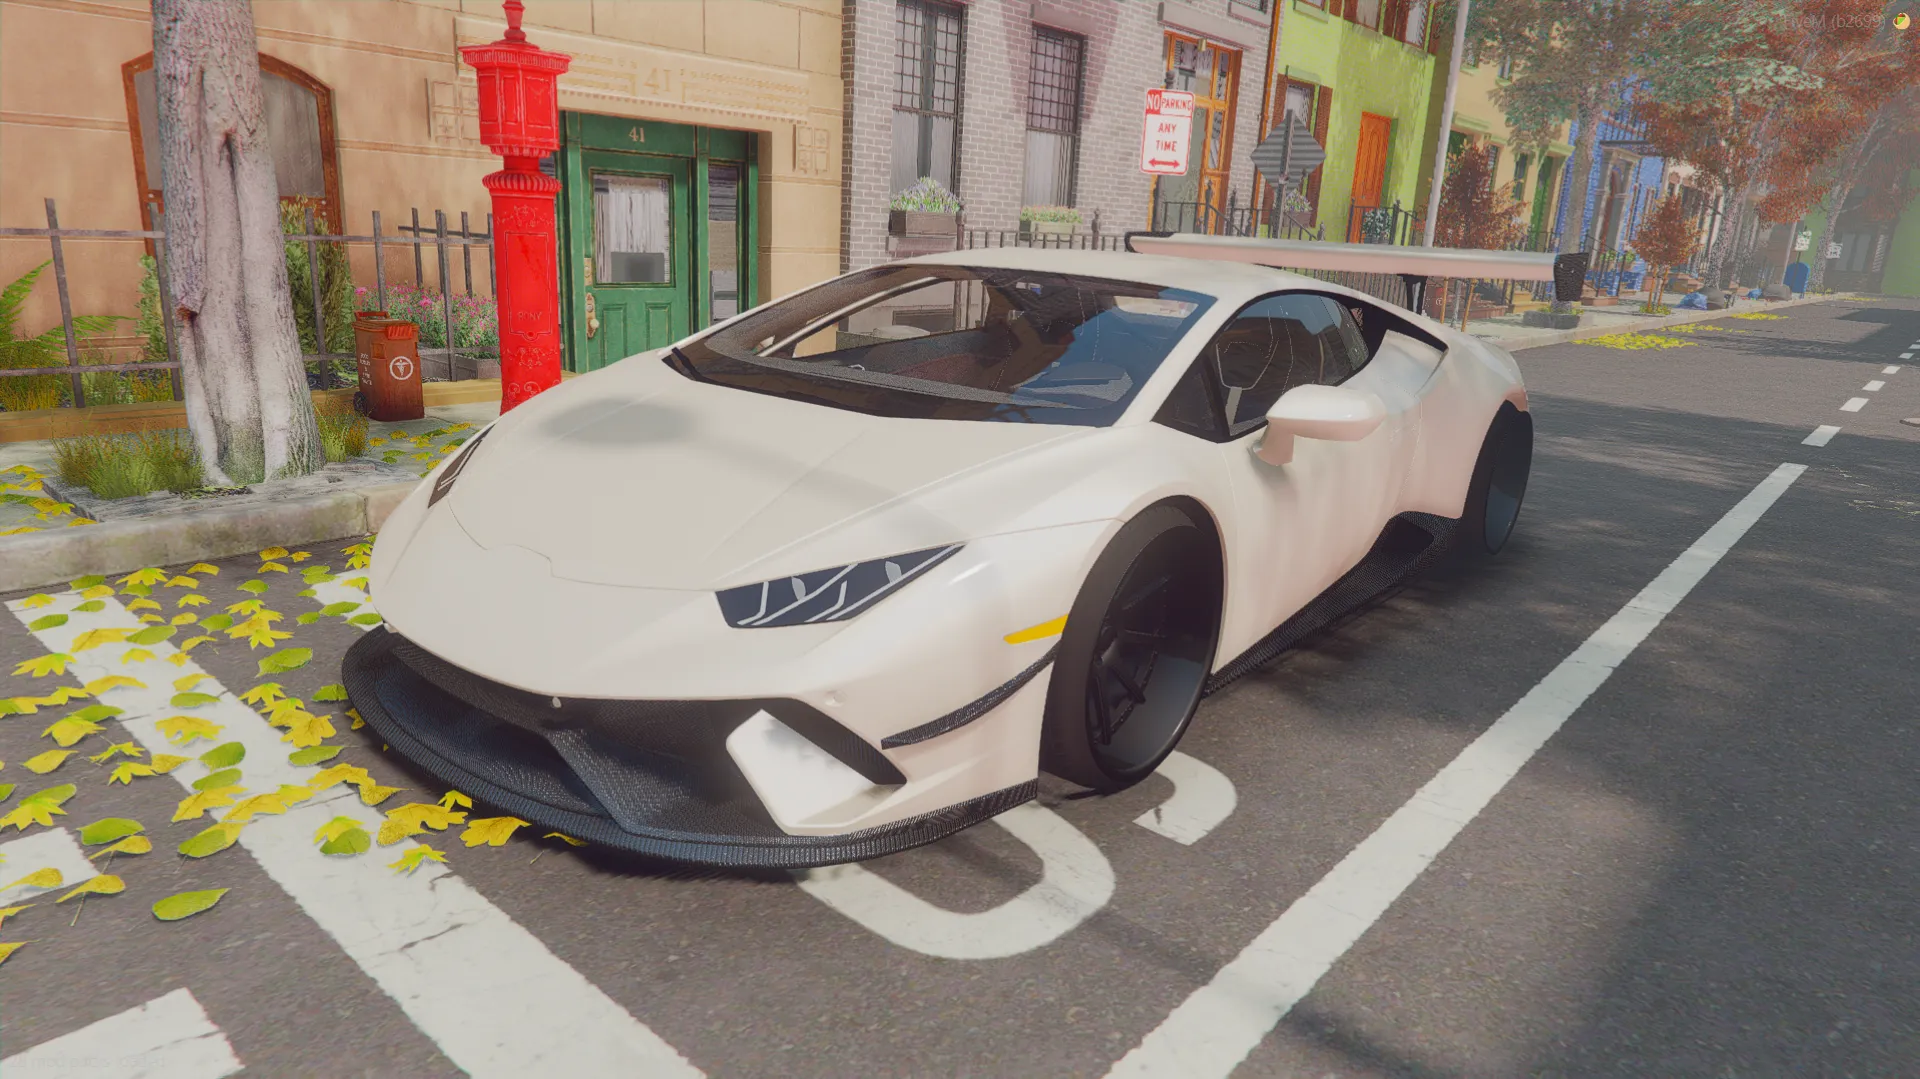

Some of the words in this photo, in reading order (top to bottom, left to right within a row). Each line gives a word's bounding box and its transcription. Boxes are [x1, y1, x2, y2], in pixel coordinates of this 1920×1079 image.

[644, 68, 672, 95] 41
[1147, 94, 1161, 110] NO
[1161, 98, 1192, 111] PARKING
[628, 126, 645, 143] 41
[1158, 123, 1177, 133] ANY
[1156, 140, 1177, 152] TIME
